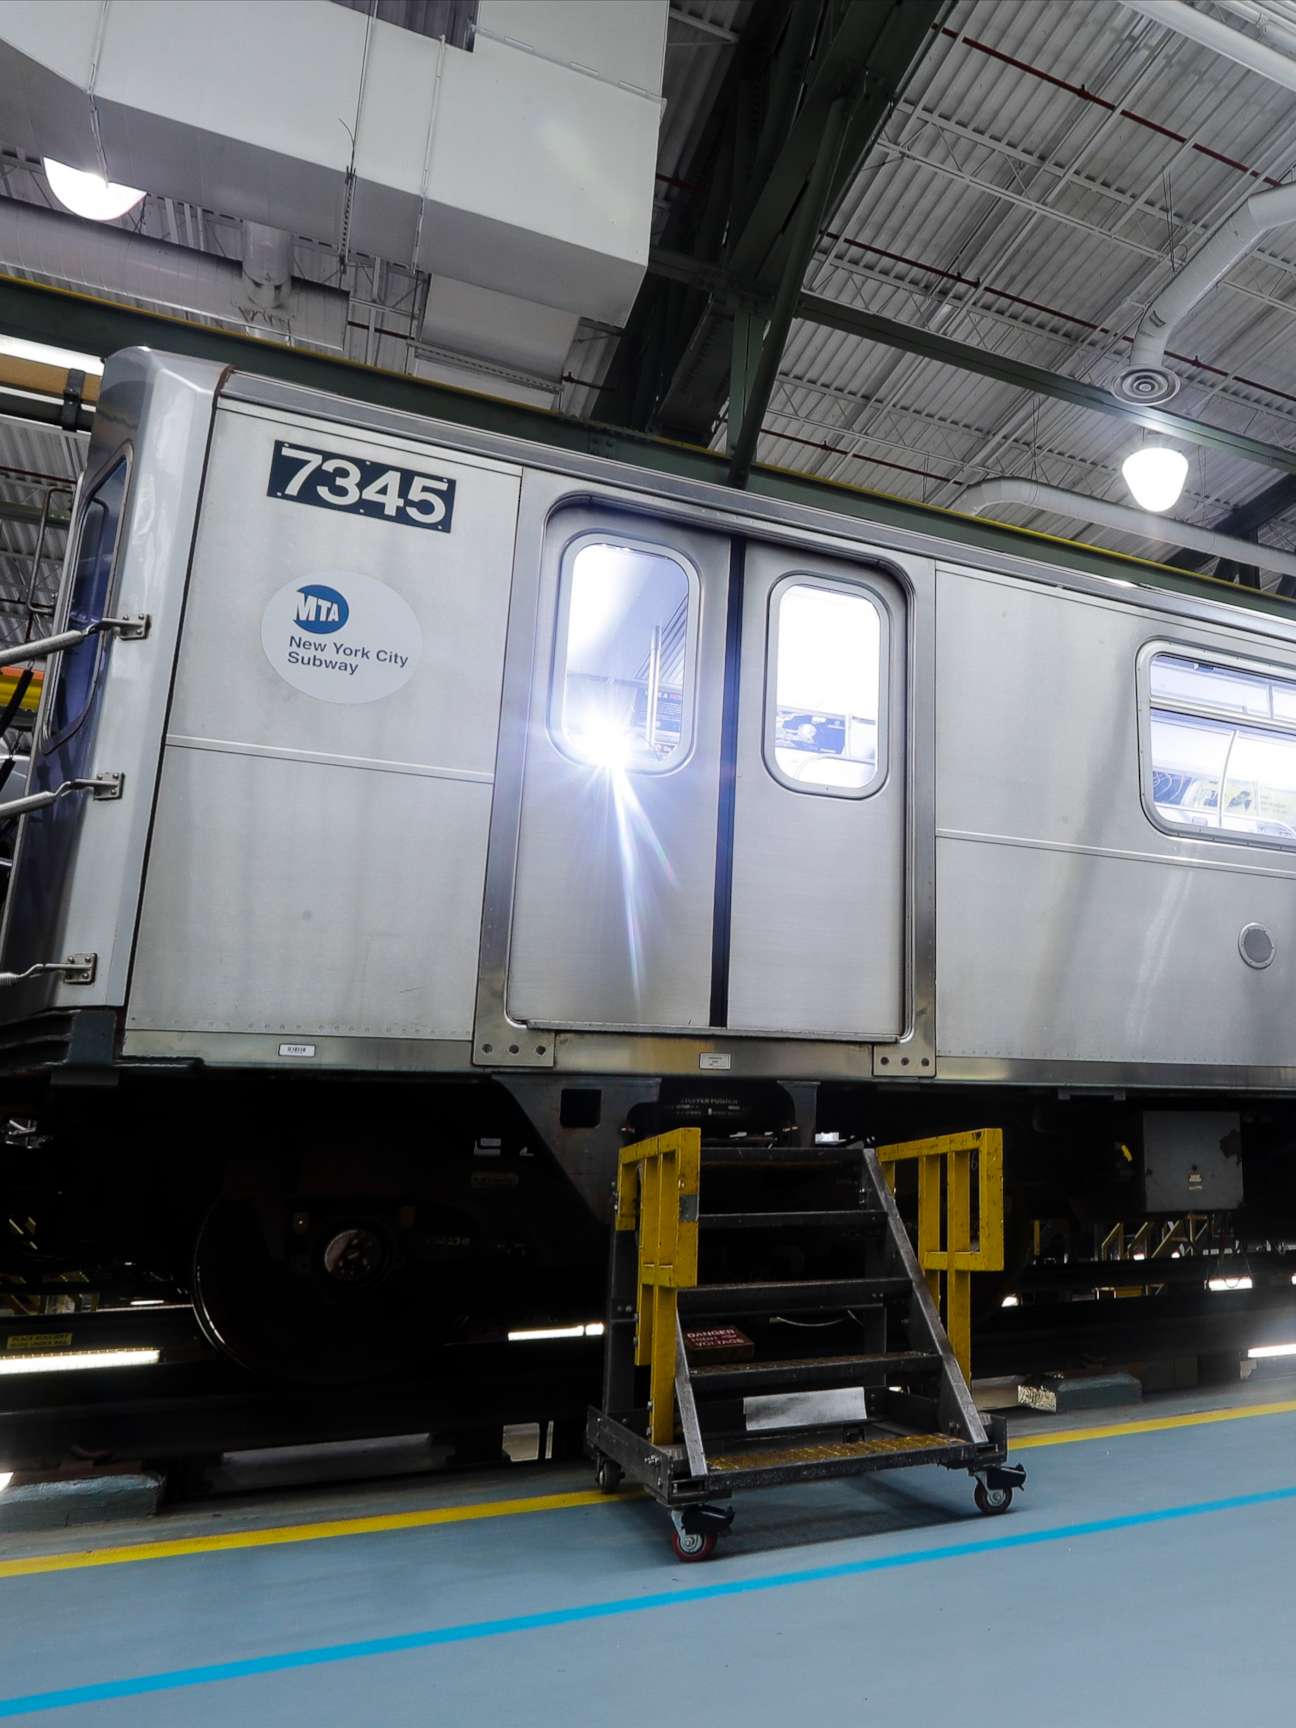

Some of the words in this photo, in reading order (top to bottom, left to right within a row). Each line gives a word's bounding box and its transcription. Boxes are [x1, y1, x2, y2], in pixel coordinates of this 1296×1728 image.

[281, 447, 448, 524] 7345
[294, 588, 342, 624] MTA
[287, 651, 359, 676] Subway
[289, 635, 327, 652] New
[332, 641, 371, 660] York
[376, 649, 409, 668] City
[687, 1329, 735, 1338] DANGER
